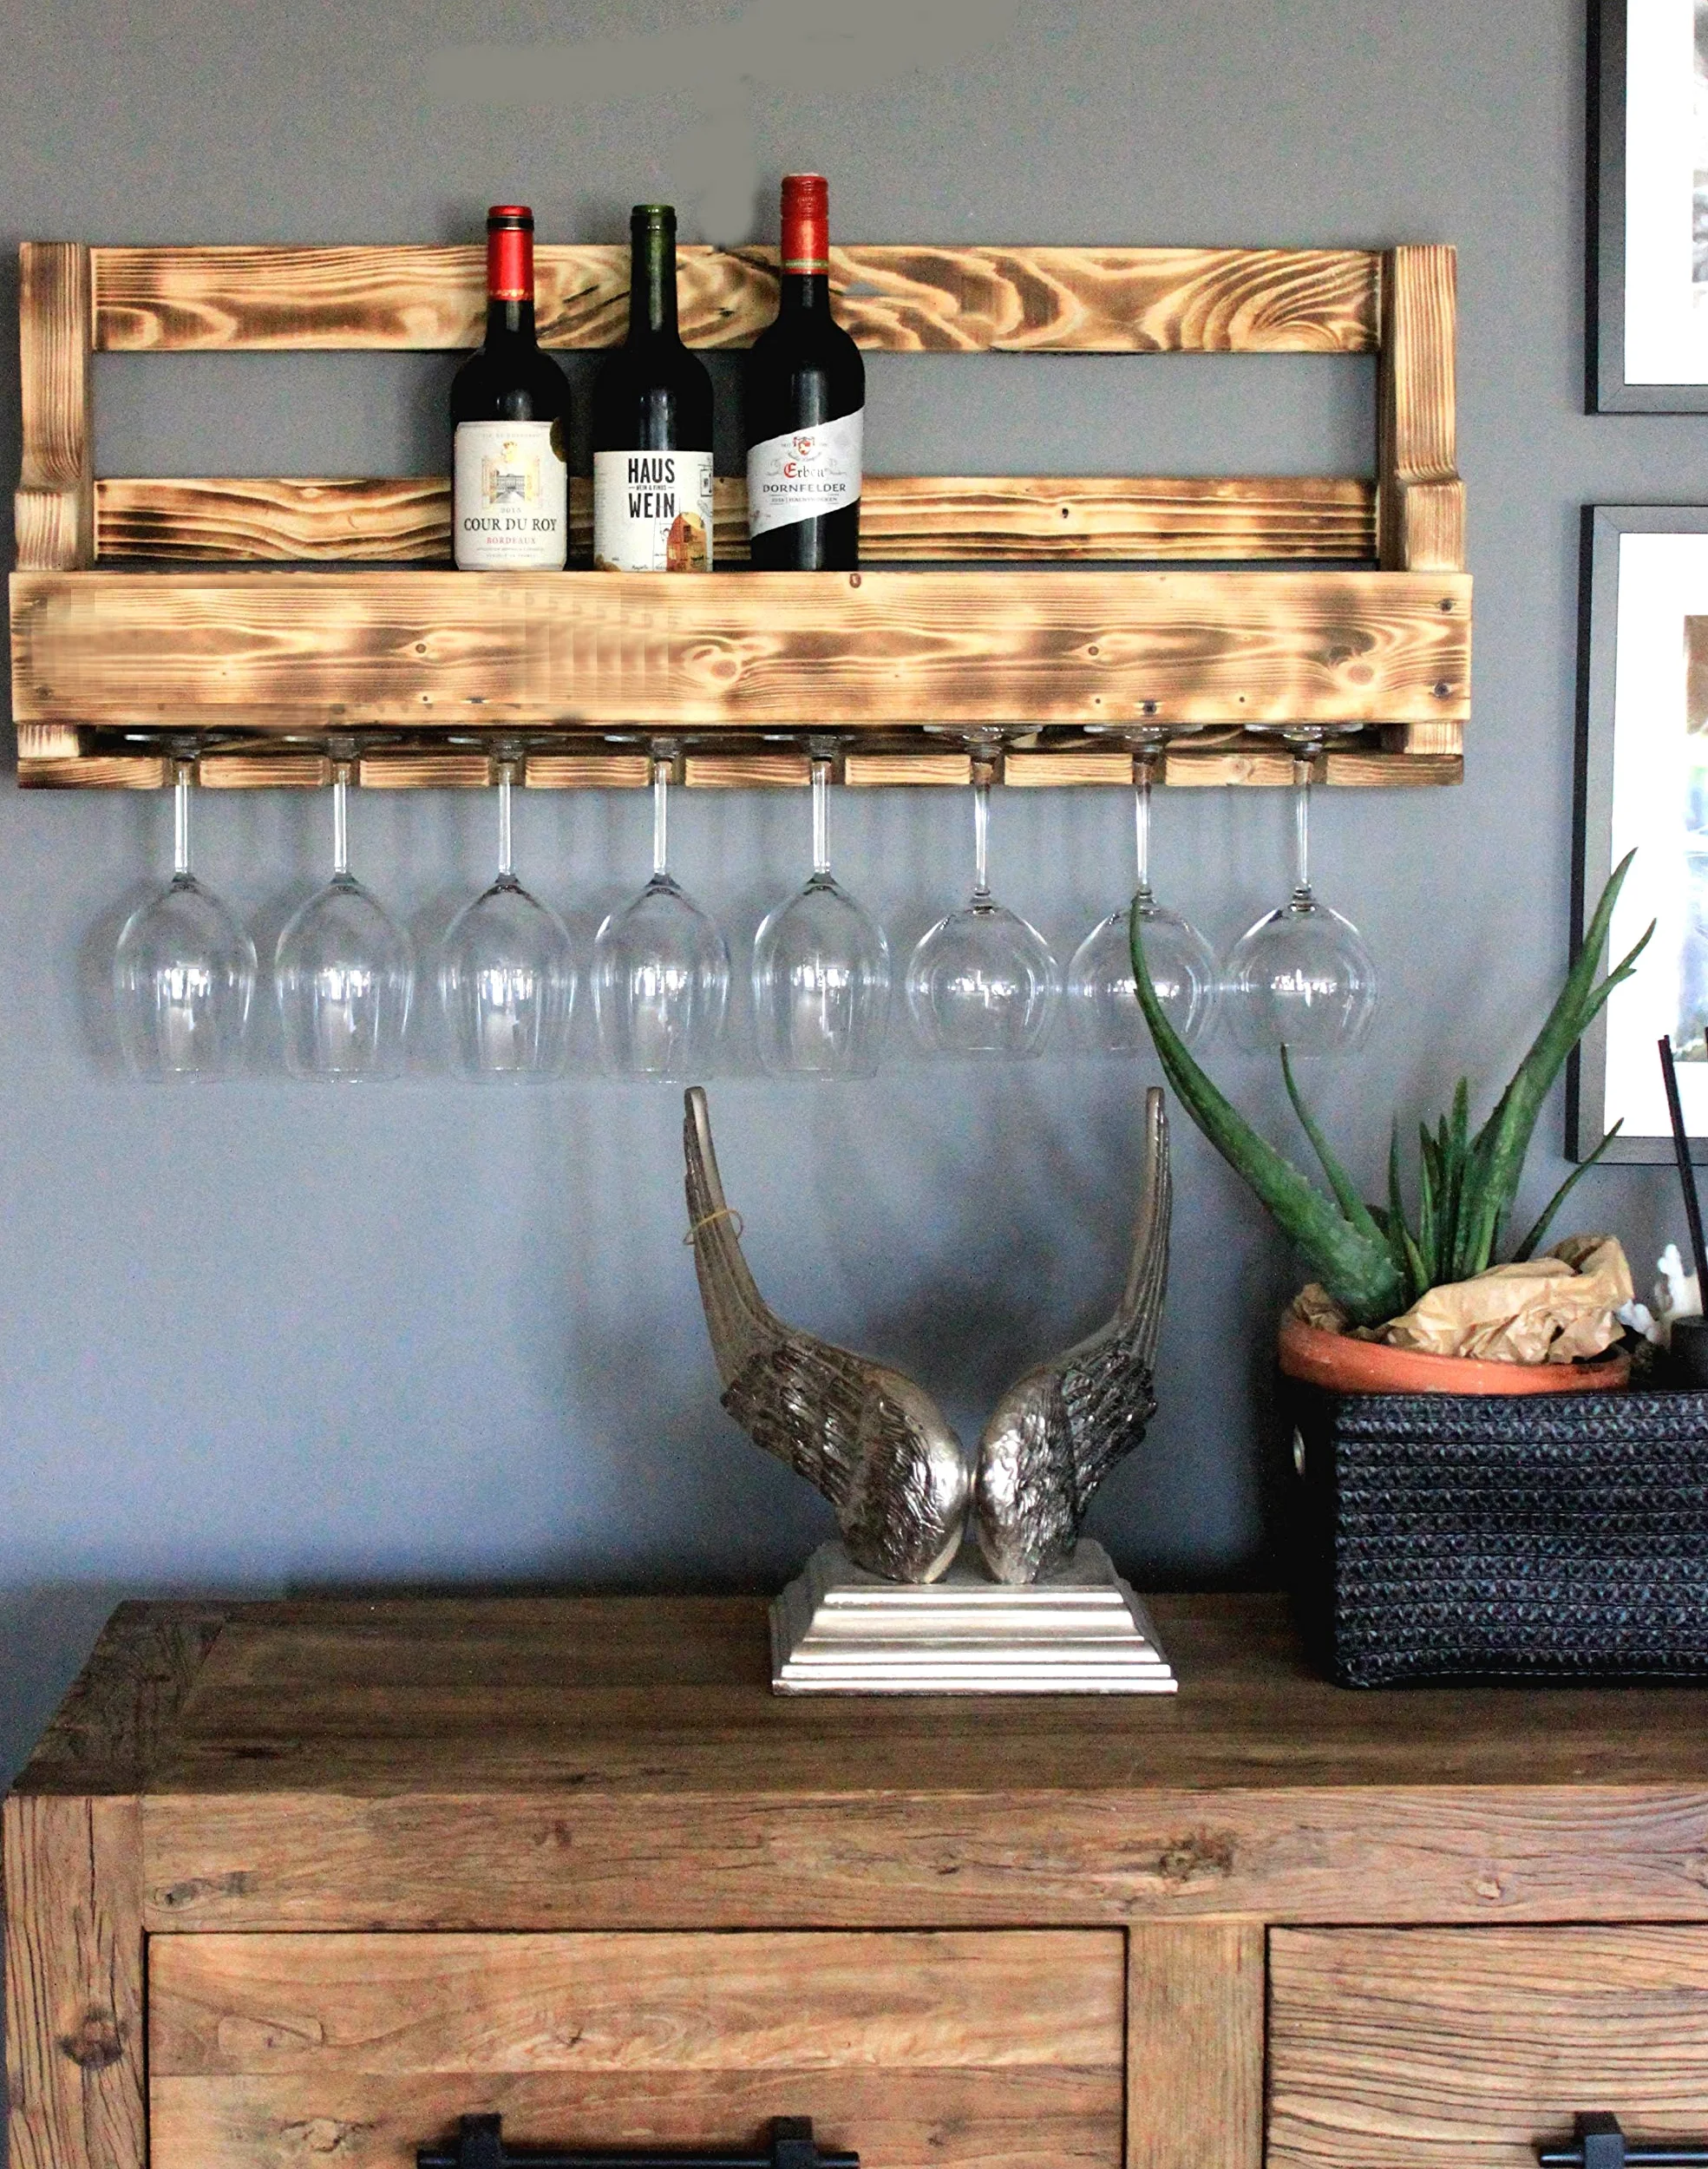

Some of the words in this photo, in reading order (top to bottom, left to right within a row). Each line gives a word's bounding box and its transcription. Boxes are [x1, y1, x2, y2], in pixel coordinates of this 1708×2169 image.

[628, 458, 676, 483] HAUS
[783, 462, 825, 478] Erben
[762, 483, 847, 493] DORNFELDER
[628, 493, 675, 518] WEIN
[464, 518, 501, 531] COUR
[507, 518, 527, 531] DU
[533, 518, 558, 531] ROY
